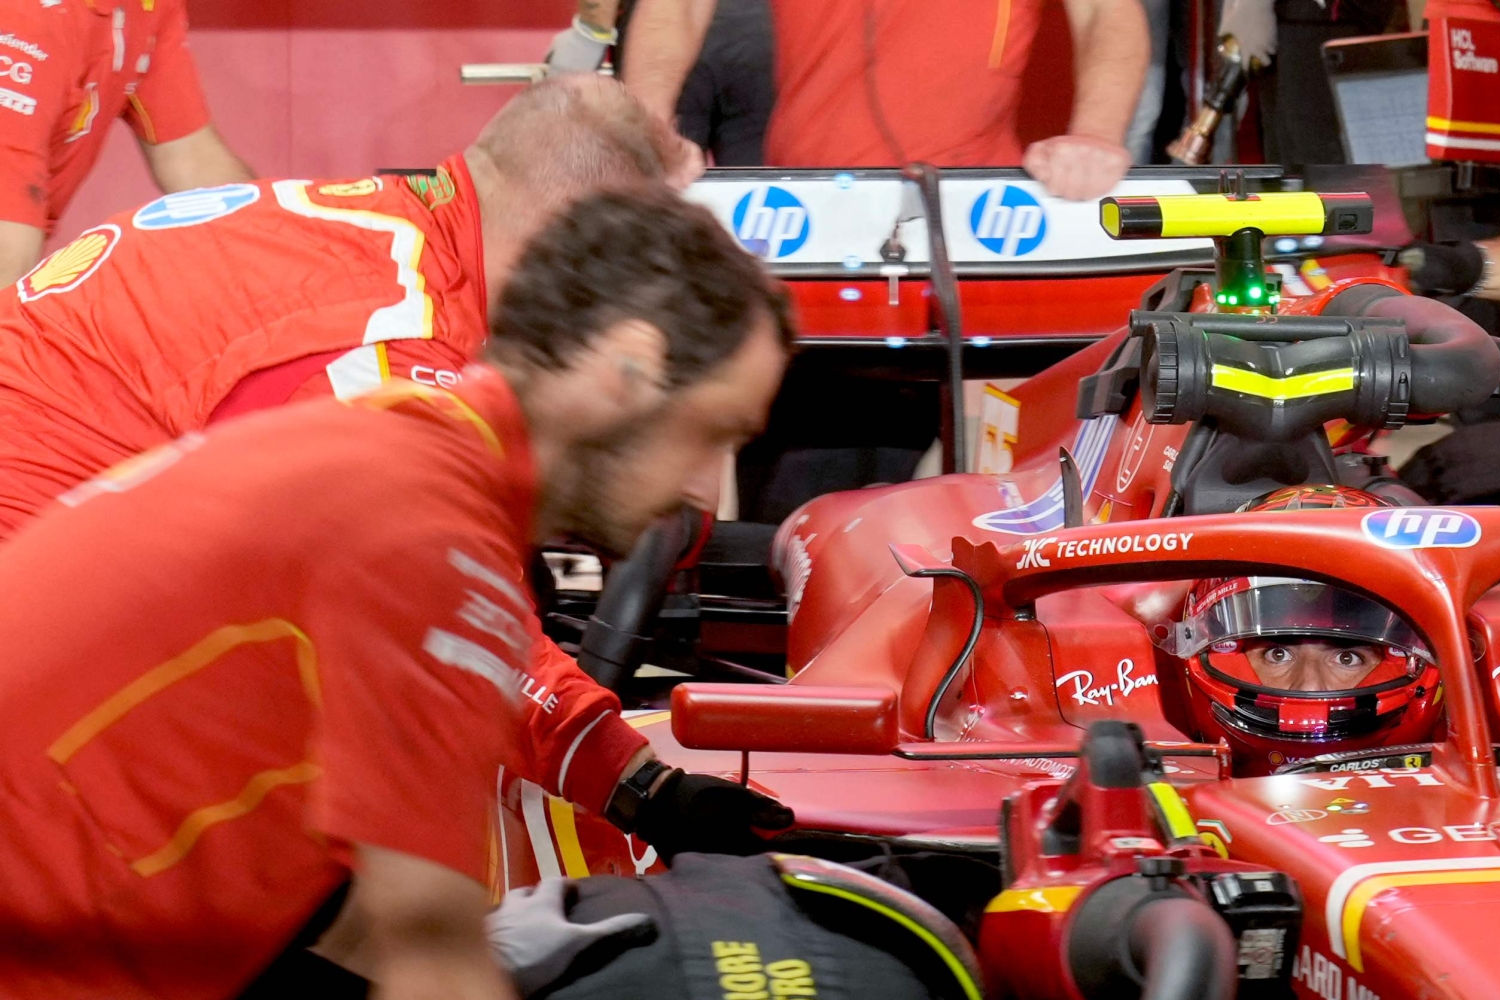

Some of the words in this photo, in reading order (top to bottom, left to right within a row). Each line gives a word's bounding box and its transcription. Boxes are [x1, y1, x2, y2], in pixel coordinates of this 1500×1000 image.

[1451, 29, 1475, 50] HCL
[1453, 50, 1498, 74] Software
[741, 187, 802, 257] hp
[977, 186, 1038, 256] hp
[411, 365, 464, 389] ce
[1384, 508, 1464, 547] hp
[1056, 532, 1194, 558] TECHNOLOGY
[1216, 582, 1239, 601] MILLE
[1056, 658, 1158, 706] Ray-Ban
[1329, 758, 1380, 774] CARLOS
